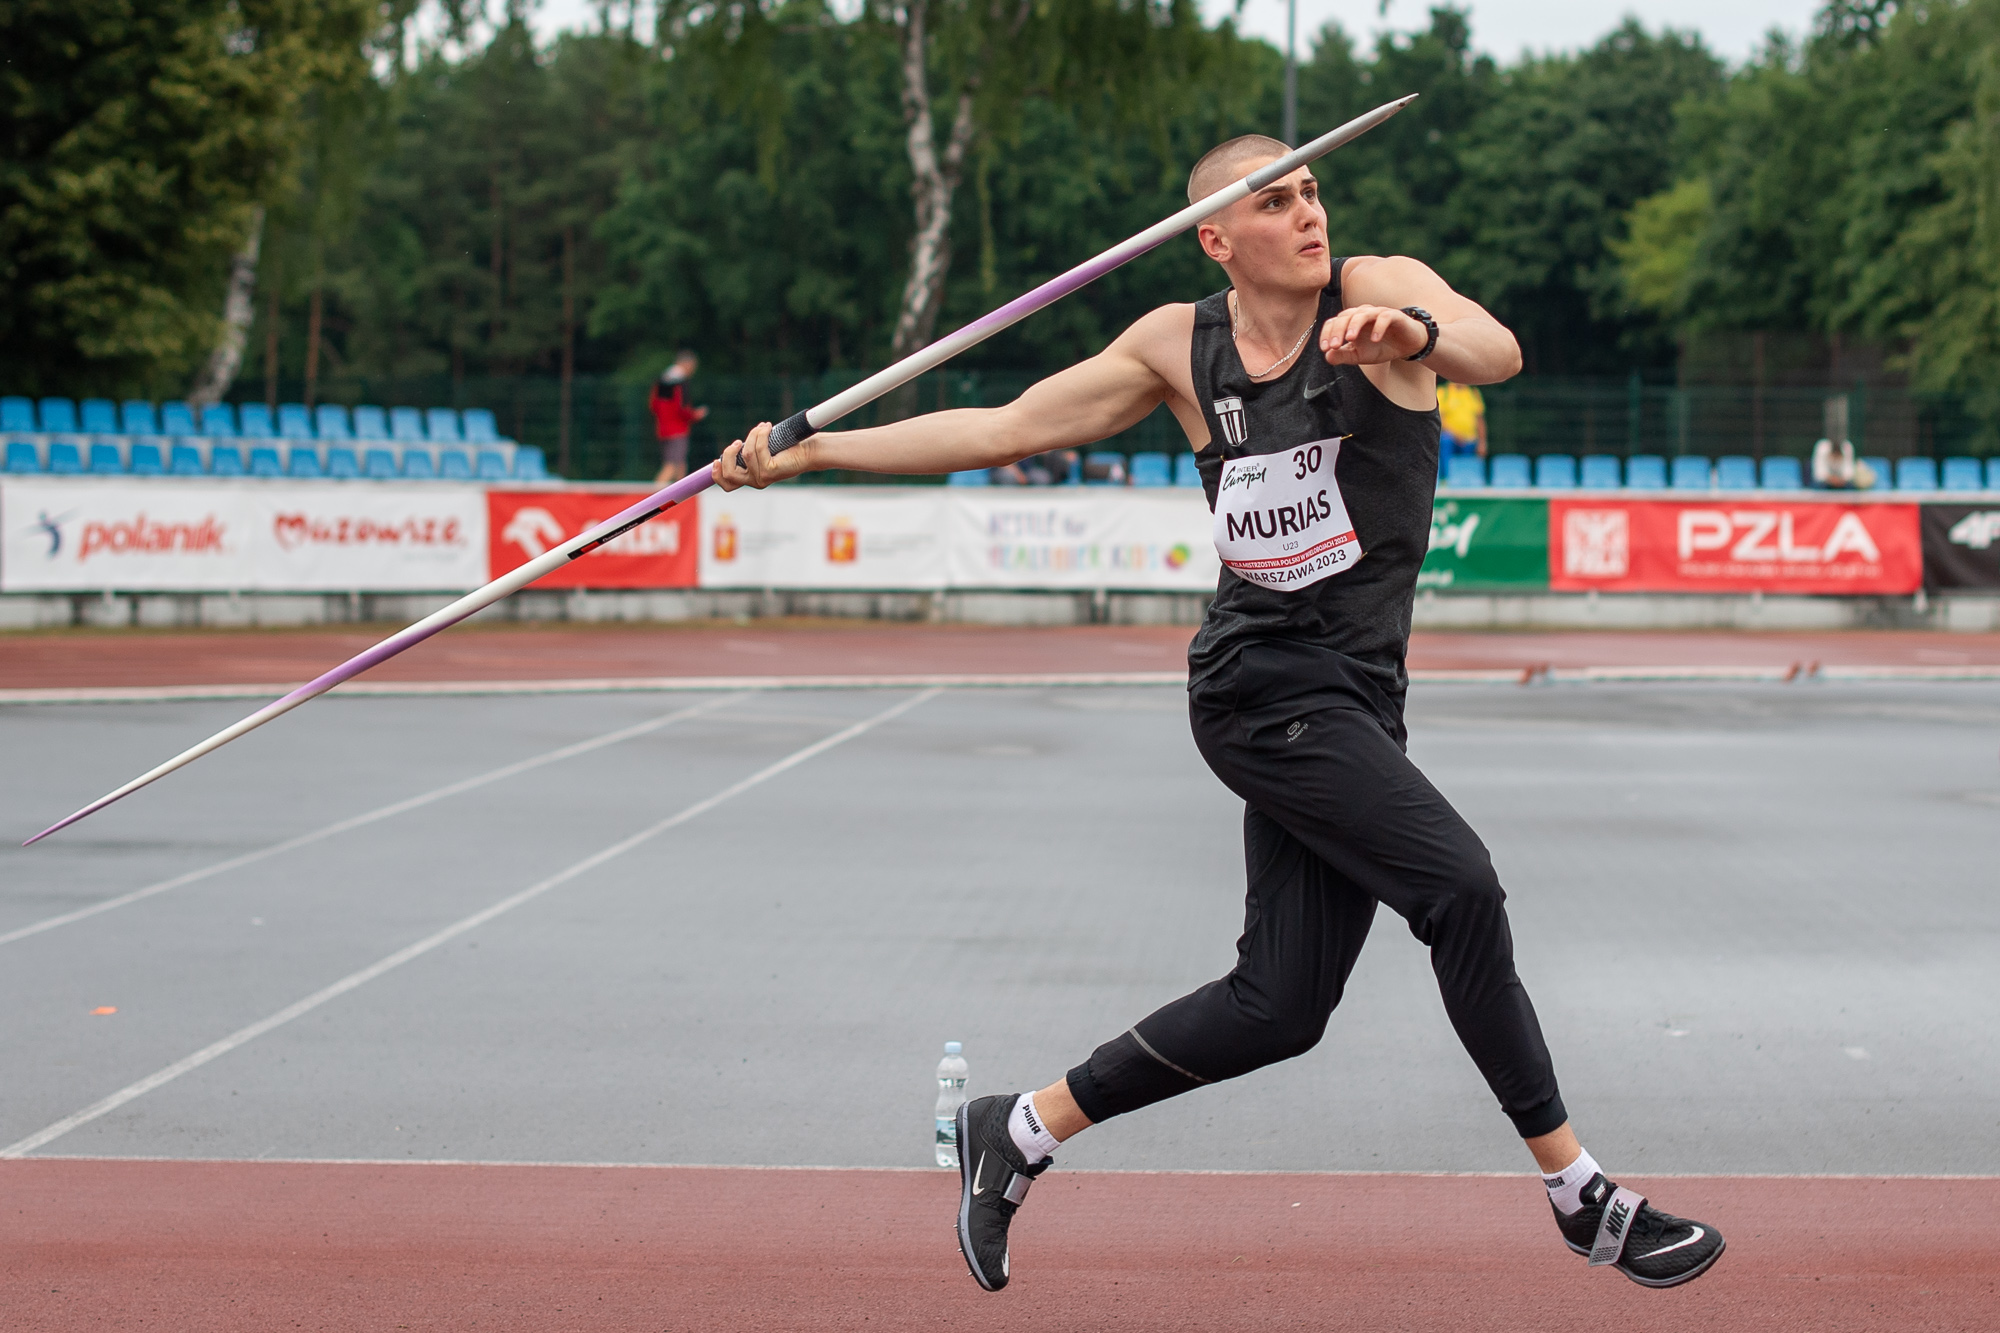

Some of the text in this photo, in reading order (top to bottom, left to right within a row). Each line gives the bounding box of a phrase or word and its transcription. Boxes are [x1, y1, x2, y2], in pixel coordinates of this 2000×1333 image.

[1222, 465, 1267, 491] Europol
[1293, 445, 1322, 480] 30
[1226, 489, 1331, 541] MURIAS
[77, 511, 225, 564] polanik
[1243, 560, 1280, 568] MISTRZOSTWA
[1280, 556, 1300, 566] POLSKI
[1334, 535, 1348, 545] 2023
[1282, 540, 1299, 551] U23
[1677, 510, 1881, 562] PZLA
[1241, 549, 1347, 583] WARSZAWA 2023
[1022, 1104, 1042, 1135] PUMA
[1605, 1198, 1631, 1240] NIKE
